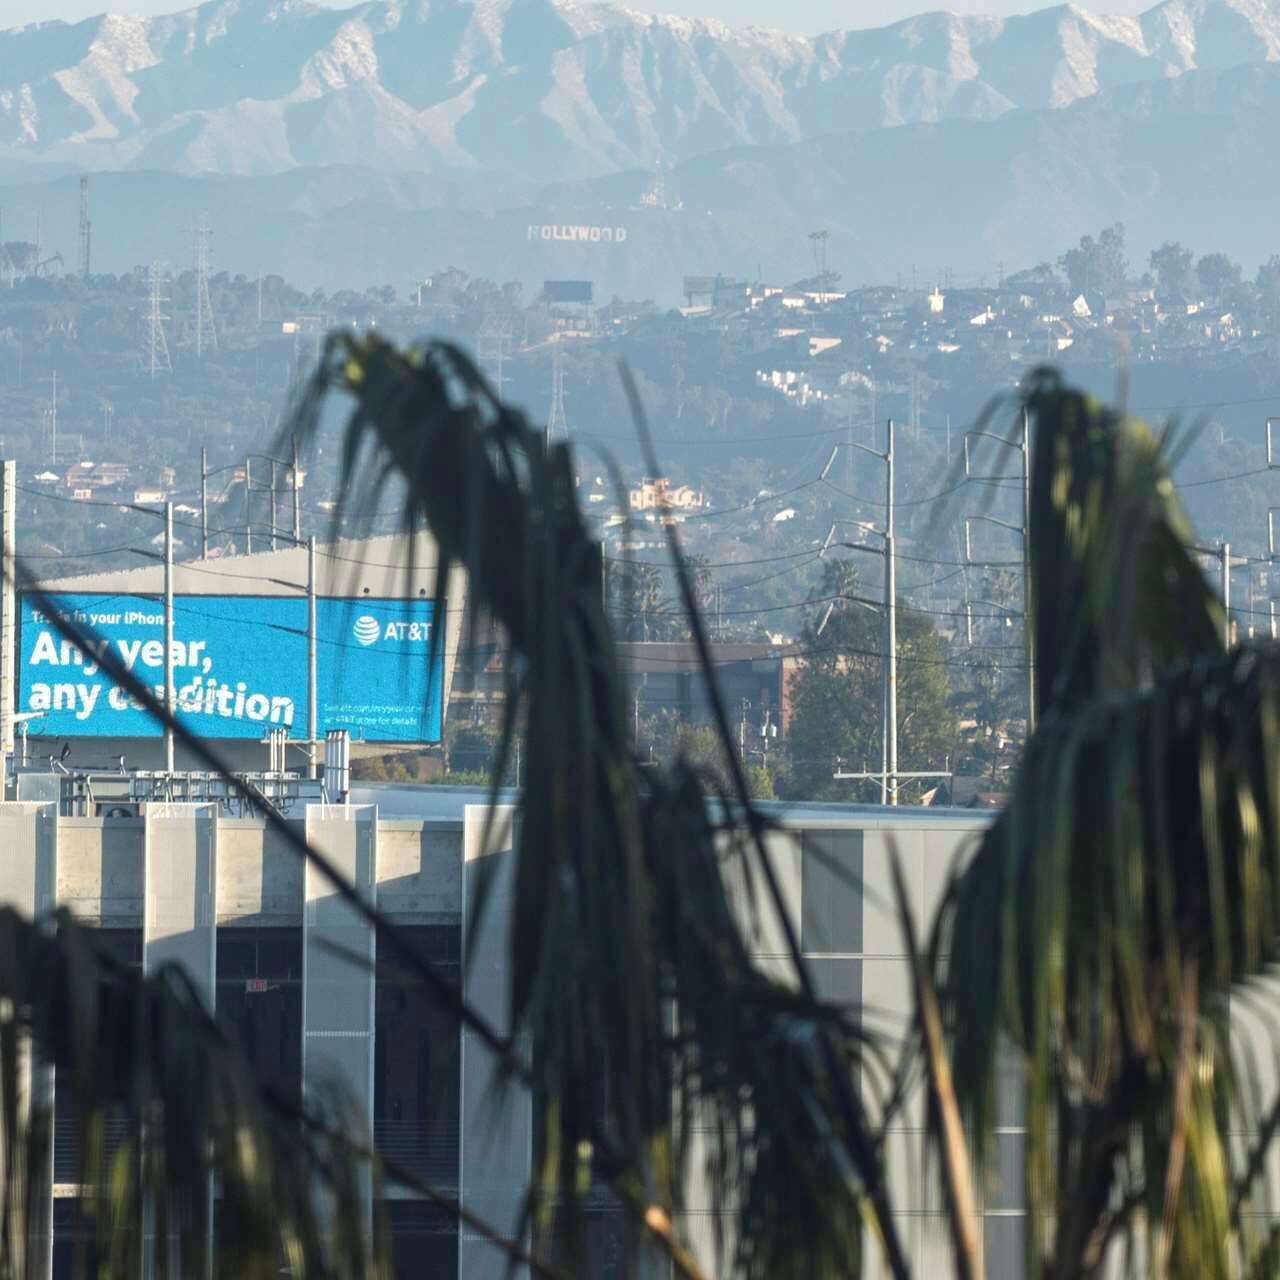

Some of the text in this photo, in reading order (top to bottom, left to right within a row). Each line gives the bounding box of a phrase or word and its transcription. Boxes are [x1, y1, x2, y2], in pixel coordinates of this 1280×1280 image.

[90, 613, 121, 626] your
[384, 622, 432, 641] AT&T
[29, 631, 109, 676] Any
[29, 682, 101, 720] any
